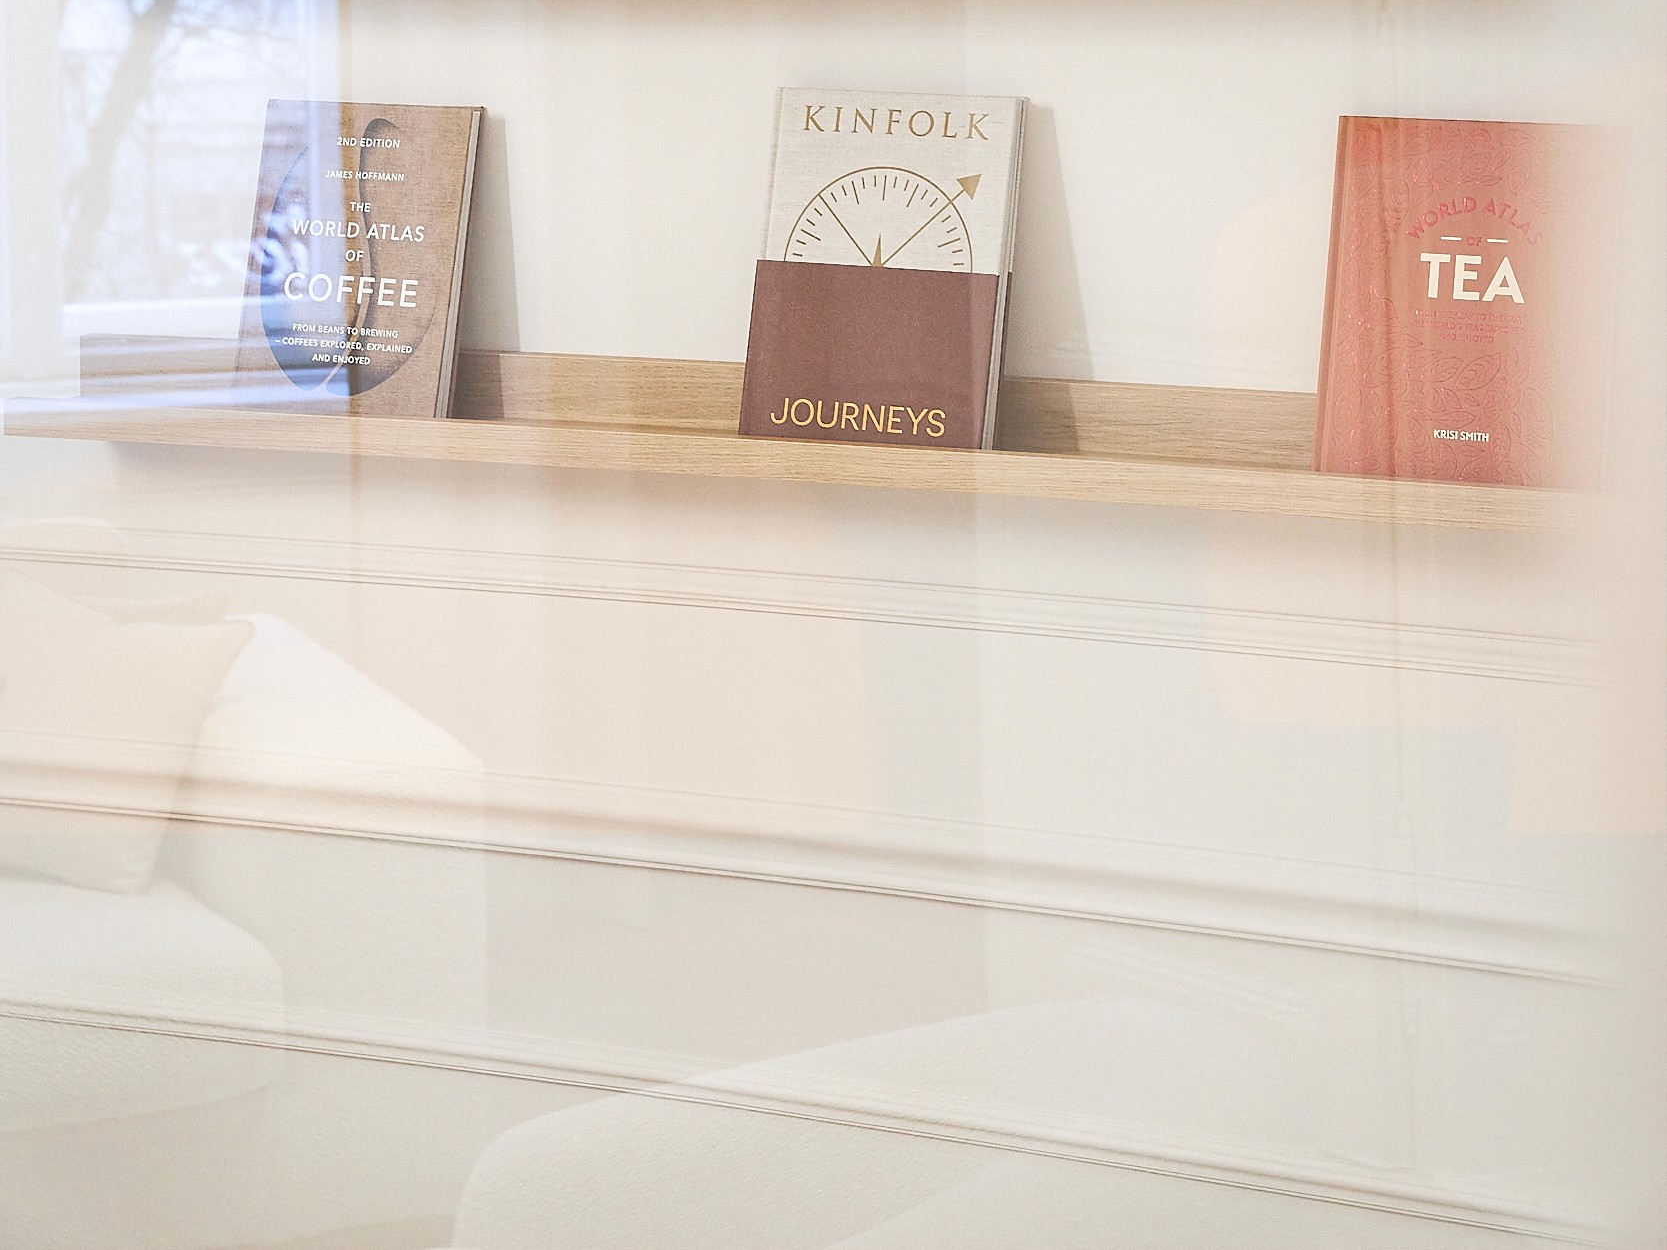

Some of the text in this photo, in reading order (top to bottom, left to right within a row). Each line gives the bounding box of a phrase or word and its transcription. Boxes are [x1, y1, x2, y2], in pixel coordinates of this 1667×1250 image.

[803, 104, 990, 141] KINFOLK
[336, 136, 400, 148] 2ND EDITION
[325, 170, 405, 182] JAMES HOFFMANN
[350, 201, 371, 213] THE
[1405, 196, 1542, 245] WORLD ATLAS
[292, 219, 426, 243] WORLD ATLAS
[1467, 236, 1482, 247] OF
[345, 249, 365, 262] OF
[1419, 252, 1525, 304] TEA
[284, 271, 419, 308] COFFEE
[292, 323, 399, 338] FROM BEANS TO BREWING
[282, 336, 319, 348] COFFEES
[320, 339, 365, 351] EXPLORED,
[366, 342, 413, 354] EXPLAINED
[312, 353, 371, 365] AND ENJOYED
[770, 397, 946, 438] JOURNEYS
[1433, 429, 1490, 442] KRISI SMITH
